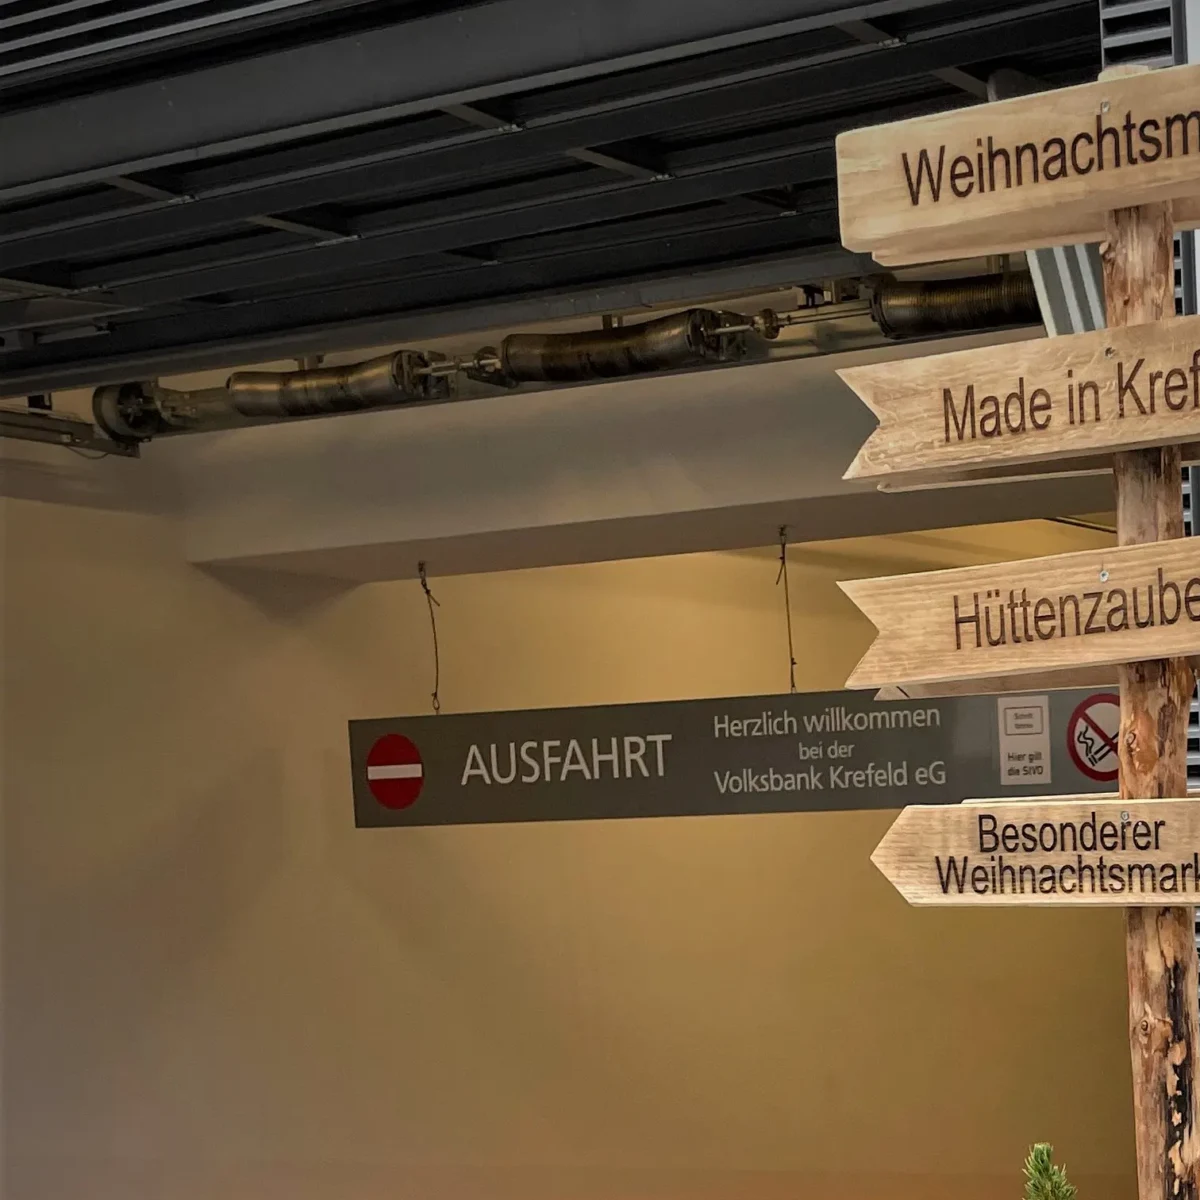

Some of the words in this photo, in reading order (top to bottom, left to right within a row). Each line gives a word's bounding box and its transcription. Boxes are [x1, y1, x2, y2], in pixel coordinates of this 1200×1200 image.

[942, 377, 1052, 443] Made
[1067, 370, 1101, 425] in
[714, 711, 798, 739] Herzlich
[803, 706, 940, 734] willkommen
[460, 733, 673, 787] AUSFAHRT
[798, 741, 822, 760] bei
[826, 739, 854, 760] der
[1007, 752, 1026, 762] Hier
[713, 766, 825, 794] Volksbank
[829, 764, 908, 790] Krefeld
[914, 761, 947, 786] eG
[1007, 766, 1020, 776] die
[978, 812, 1166, 853] Besonderer
